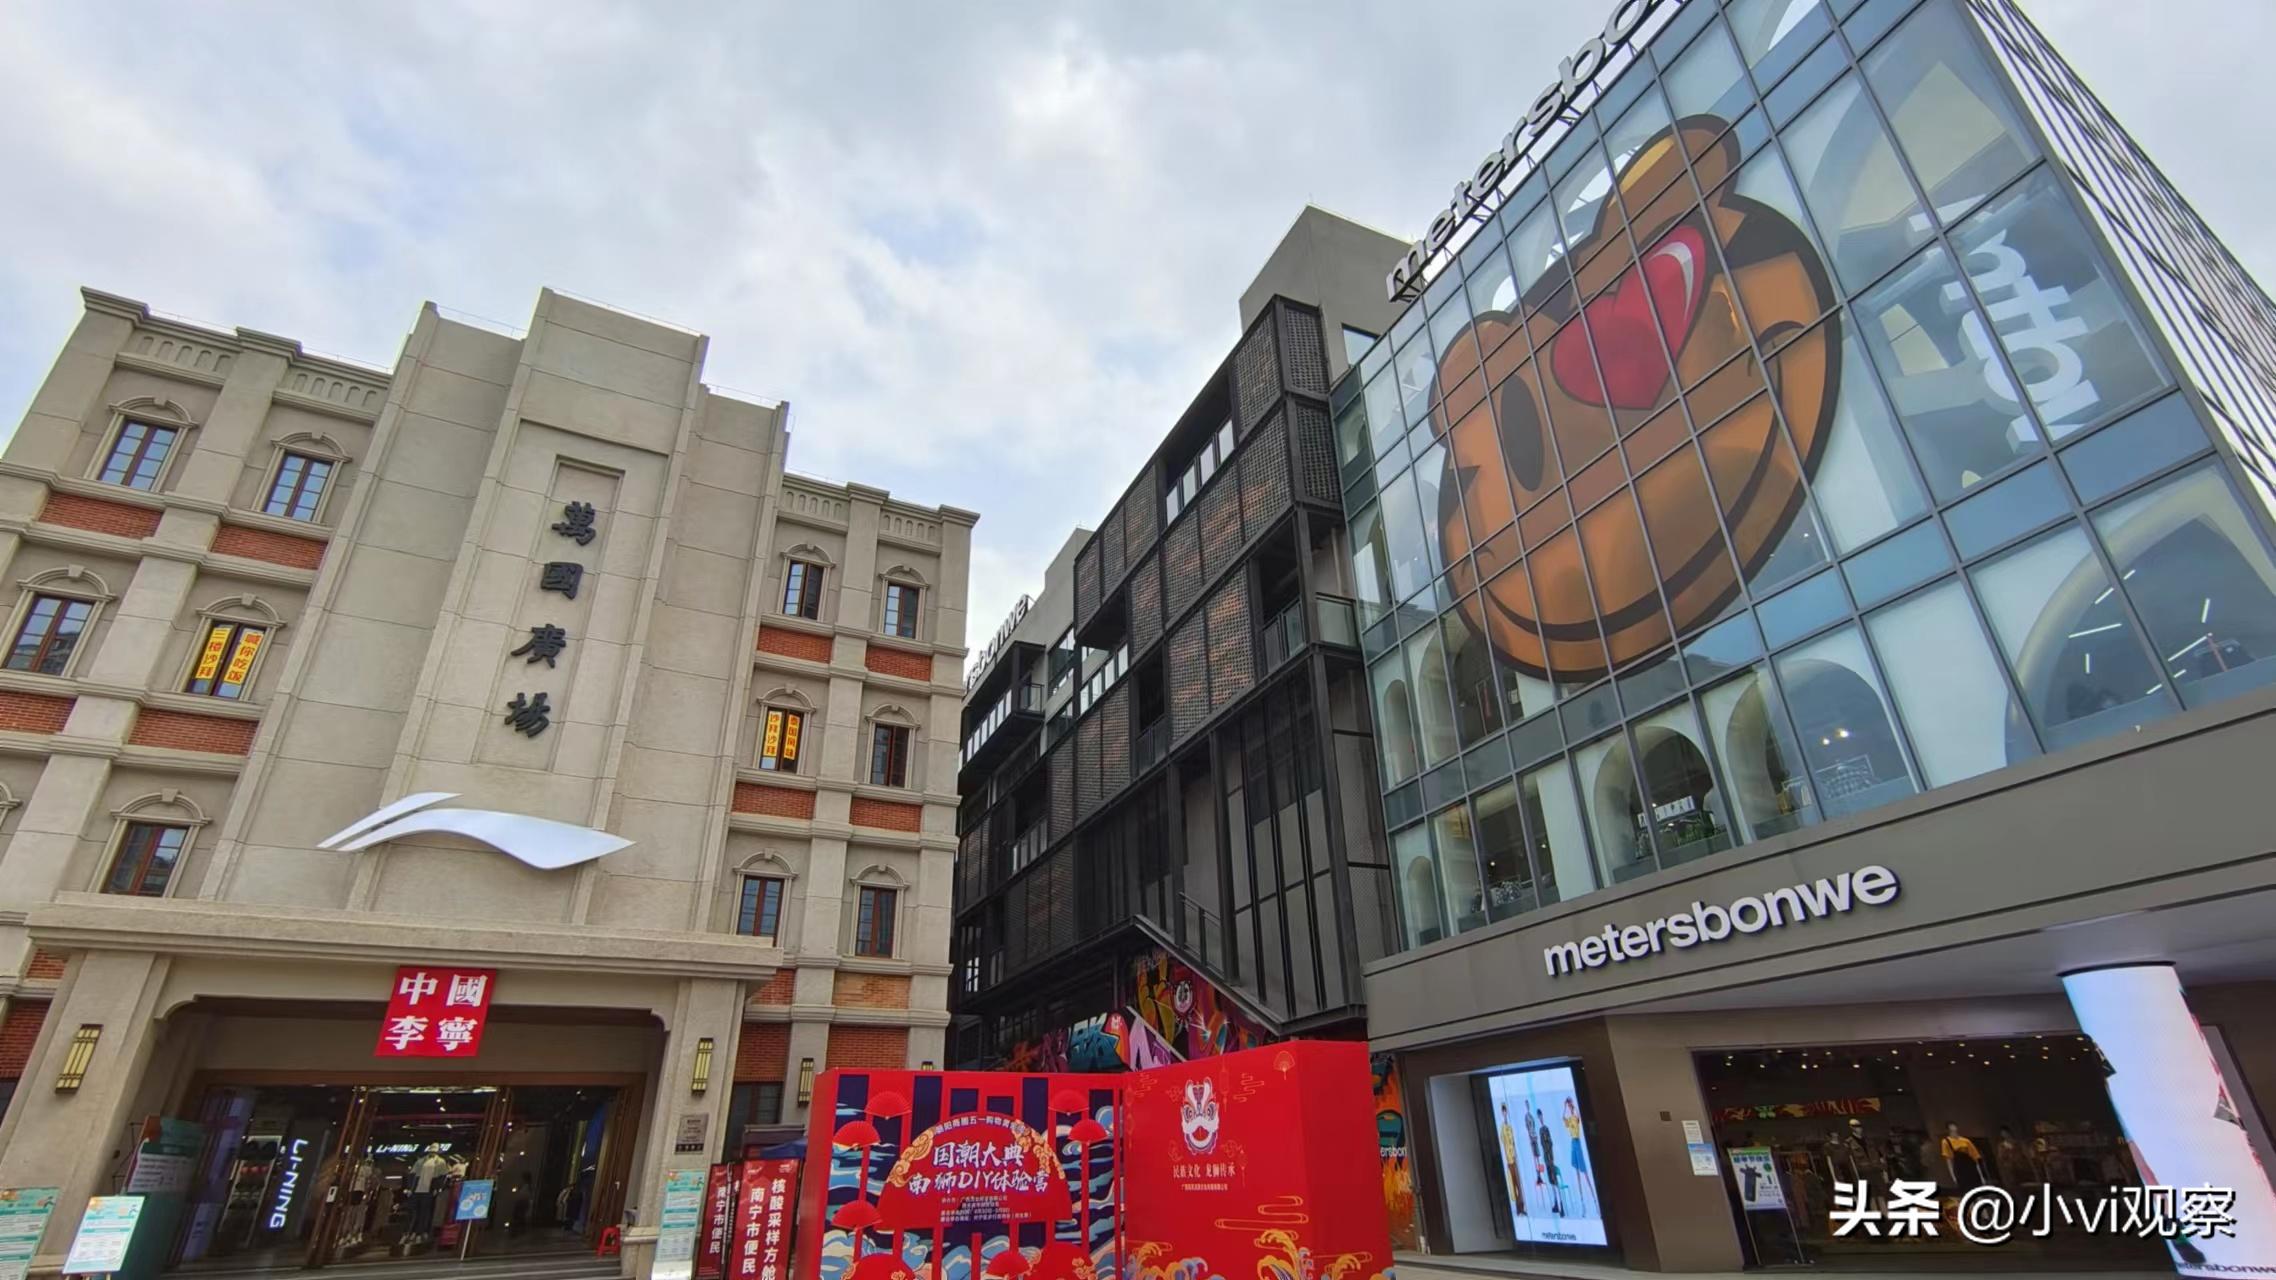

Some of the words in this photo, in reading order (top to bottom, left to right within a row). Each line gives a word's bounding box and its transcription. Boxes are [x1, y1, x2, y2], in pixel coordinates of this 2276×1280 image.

[1387, 0, 1652, 301] metersbo
[1544, 866, 1898, 976] metersbonwe
[385, 1015, 478, 1051] 李寧
[399, 971, 488, 1007] 中國
[269, 1138, 309, 1229] LI-NING
[933, 1140, 1024, 1168] 国潮大典
[742, 1187, 765, 1275] 南宁市便民
